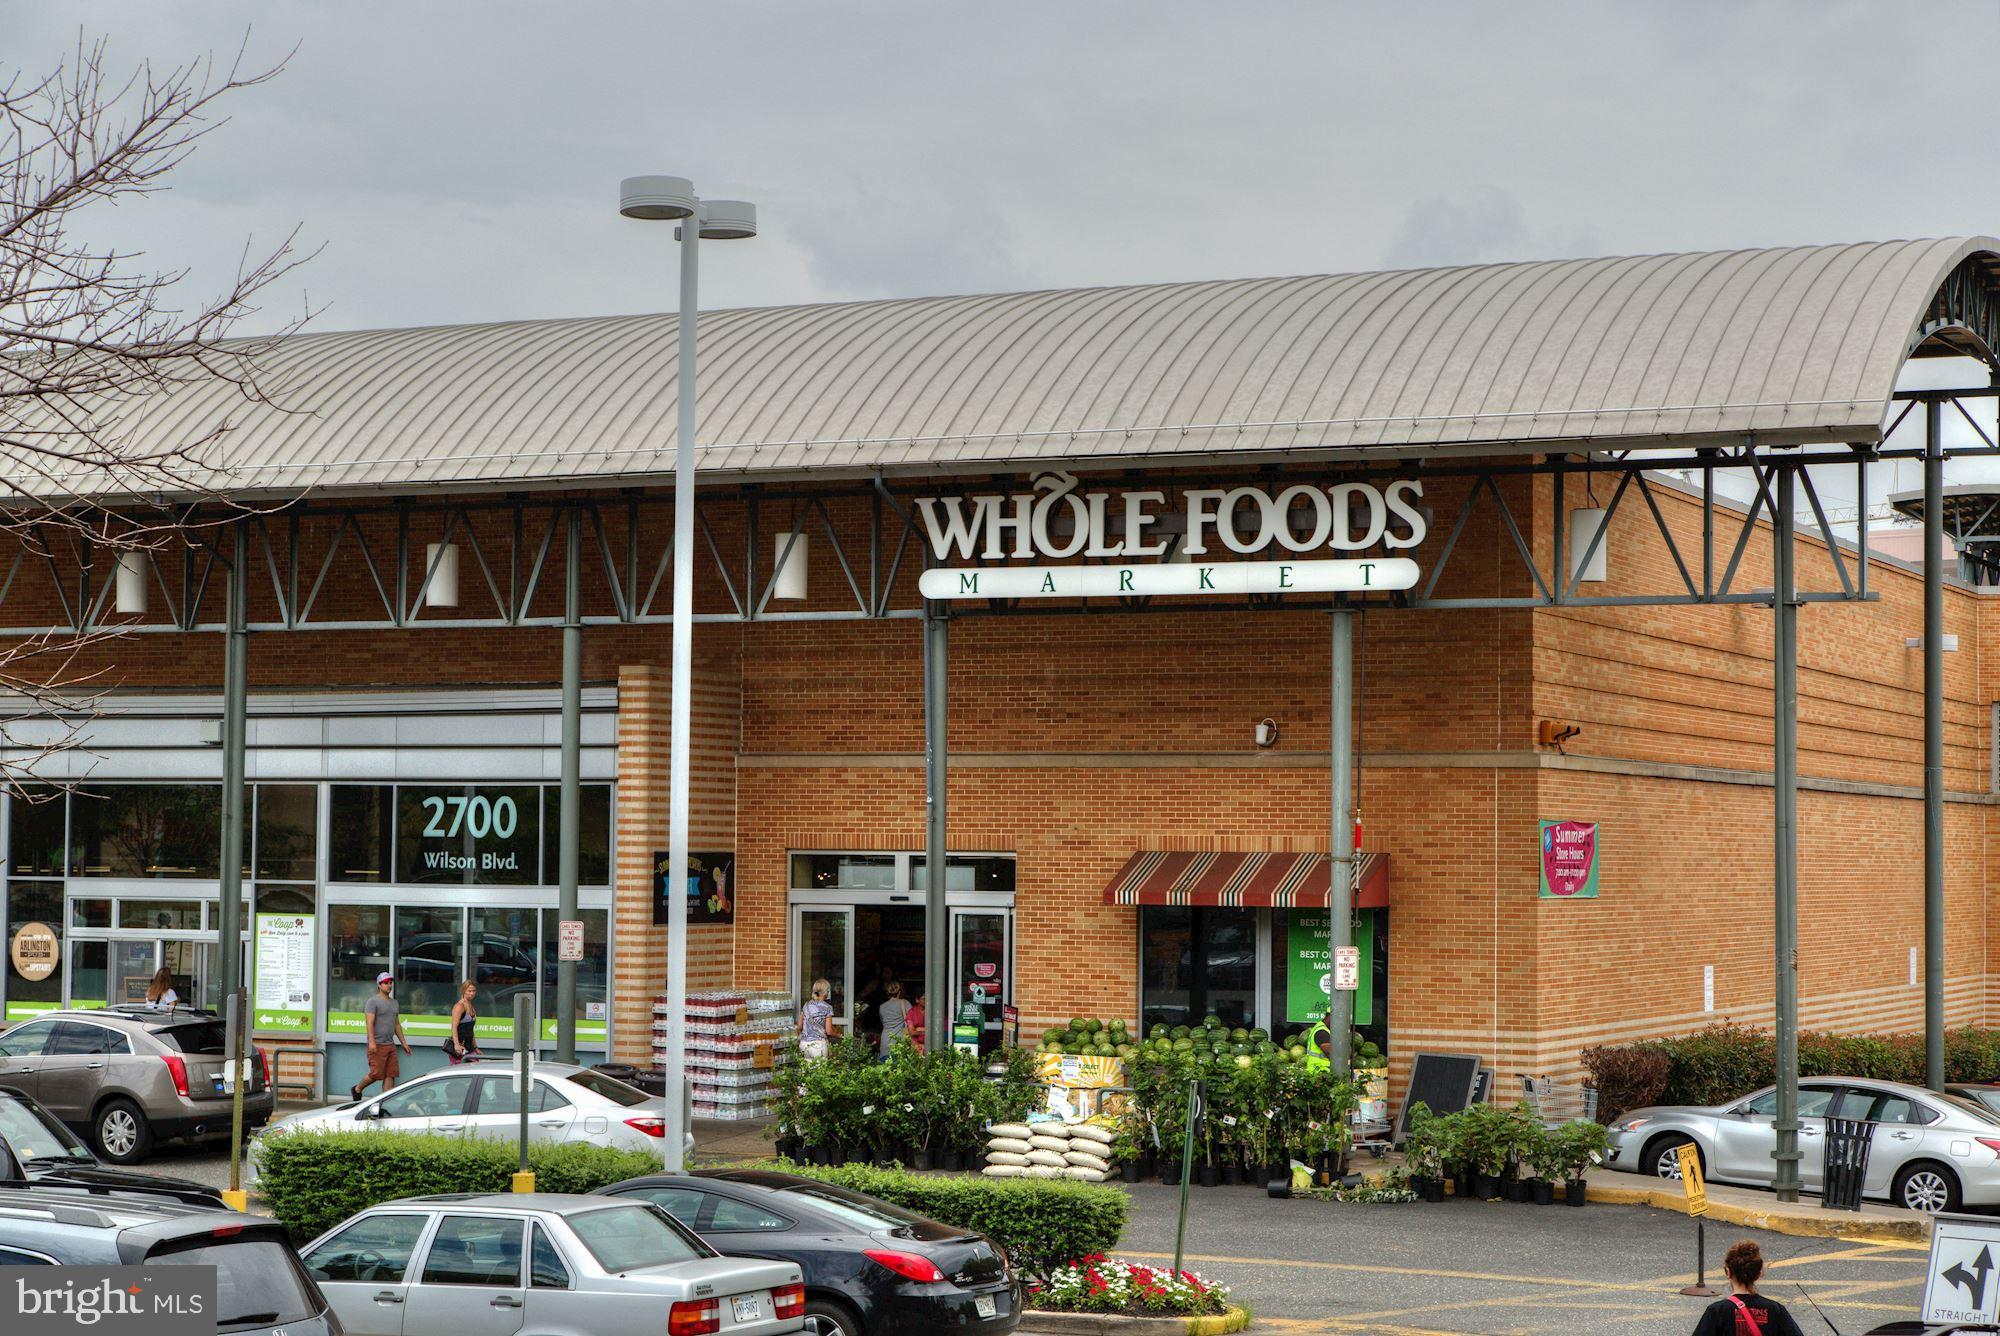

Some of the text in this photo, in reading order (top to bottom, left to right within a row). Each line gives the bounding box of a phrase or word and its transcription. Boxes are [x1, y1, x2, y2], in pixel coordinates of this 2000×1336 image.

[914, 470, 1427, 560] WHOLE FOODS
[959, 564, 1376, 594] MARKET
[422, 795, 518, 839] 2700
[1555, 825, 1585, 844] Summer
[423, 851, 519, 870] Wilson Blvd.
[1556, 846, 1584, 860] Store Hours
[1300, 919, 1320, 927] BEST
[20, 940, 51, 951] ARLINGTON
[1300, 951, 1320, 959] BEST
[1934, 1309, 1989, 1323] STRAIGHT
